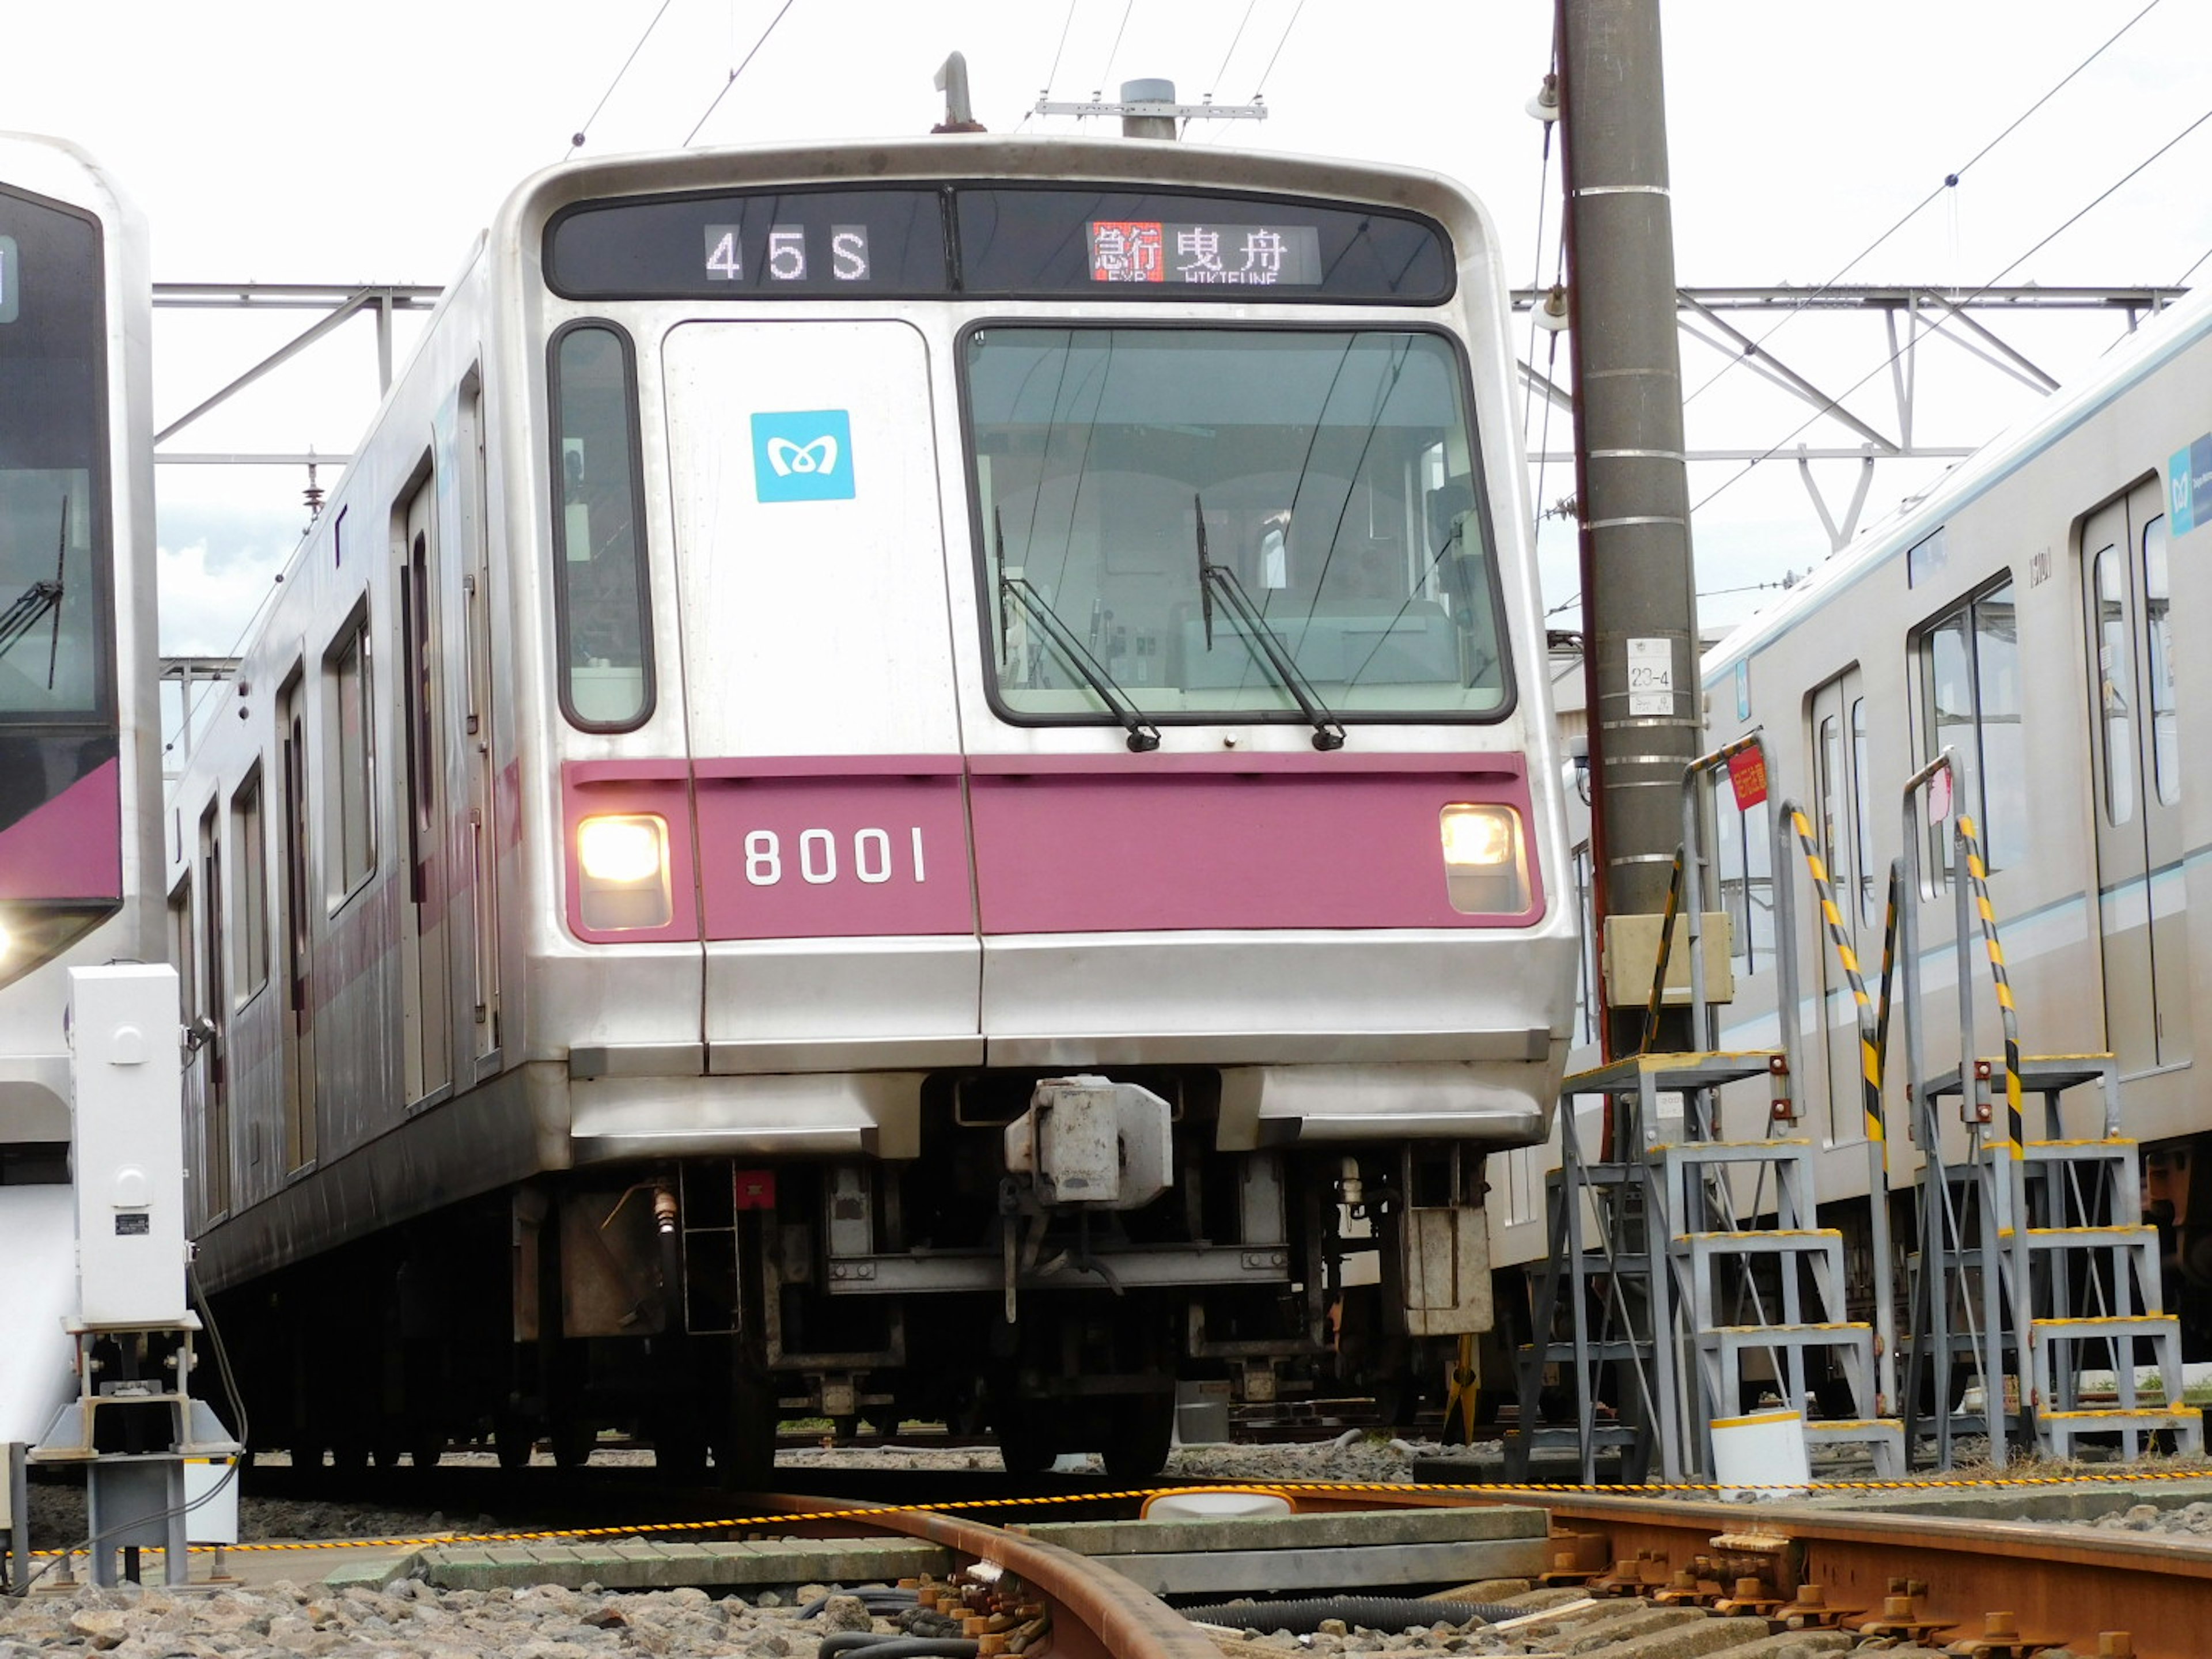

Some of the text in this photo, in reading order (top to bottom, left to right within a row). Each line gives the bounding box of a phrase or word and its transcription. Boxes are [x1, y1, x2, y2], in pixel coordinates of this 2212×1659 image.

[1094, 226, 1288, 271] 急行 曳舟
[1632, 668, 1669, 687] 23-4
[744, 827, 925, 886] 8001
